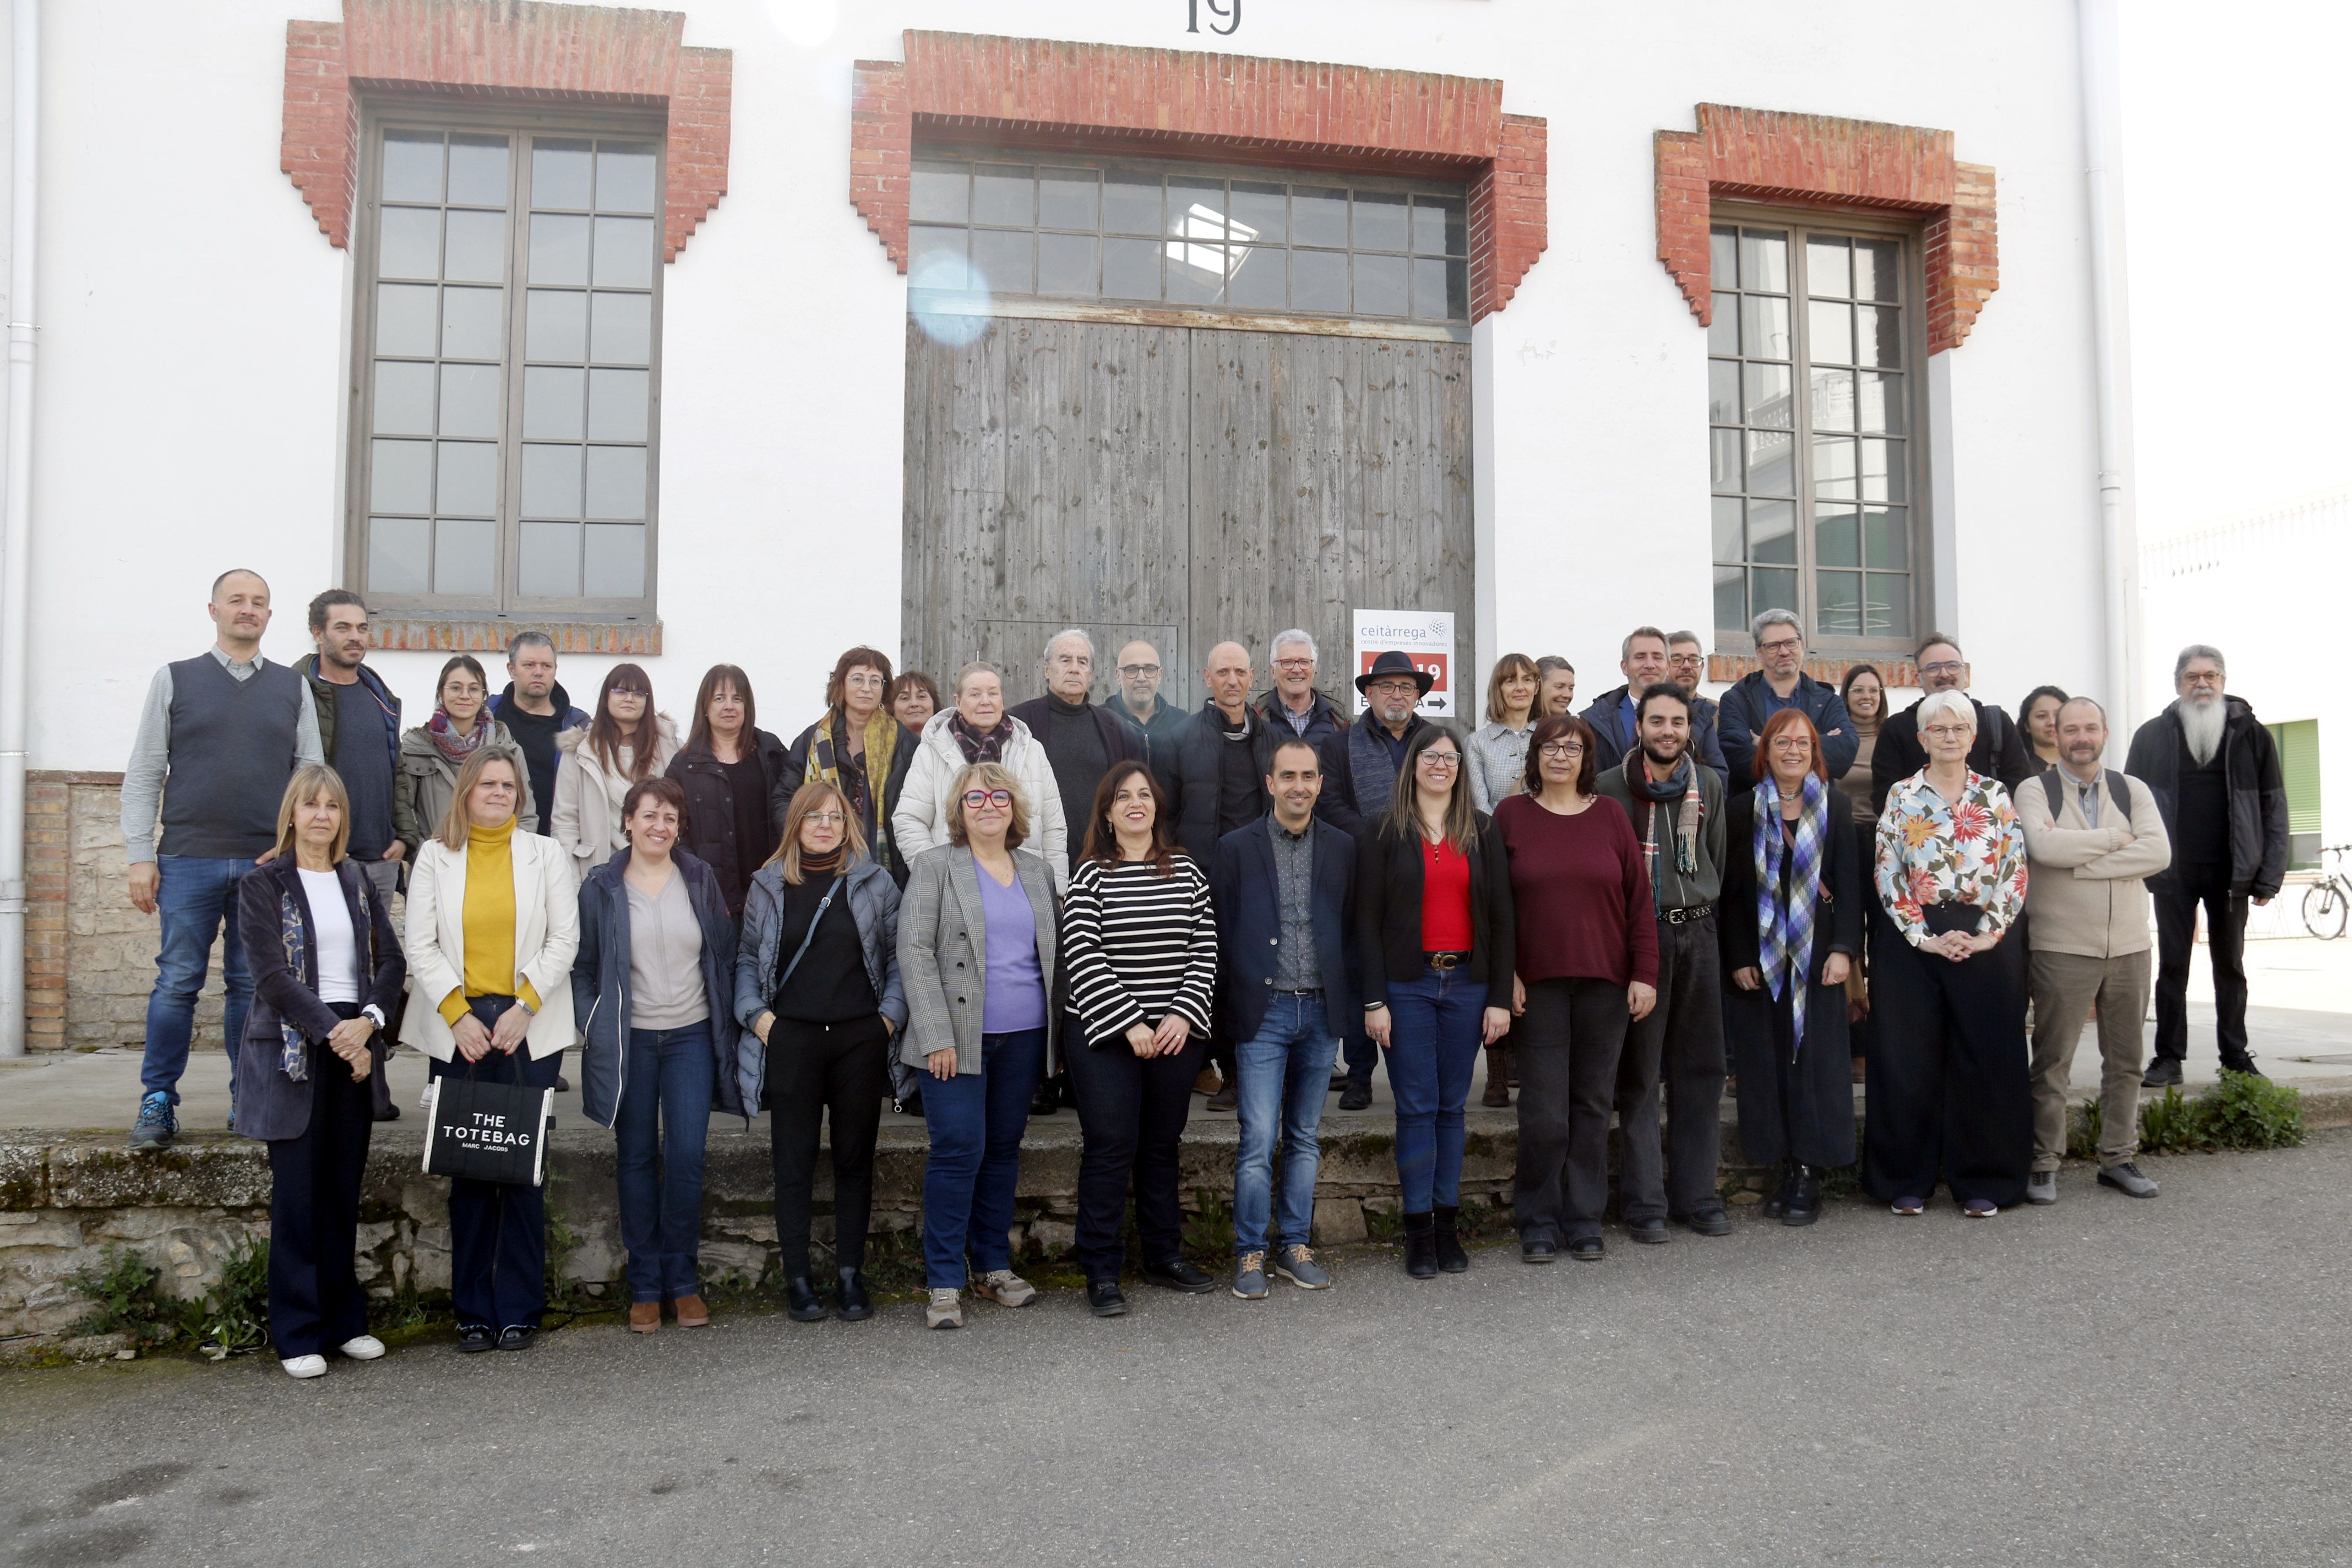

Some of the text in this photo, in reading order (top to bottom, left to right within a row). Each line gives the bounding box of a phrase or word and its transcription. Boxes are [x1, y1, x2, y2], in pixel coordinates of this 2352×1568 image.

[1185, 0, 1241, 35] 19
[1361, 625, 1426, 640] ceitàrrega
[472, 1113, 505, 1128] THE
[443, 1125, 530, 1146] TOTEBAG
